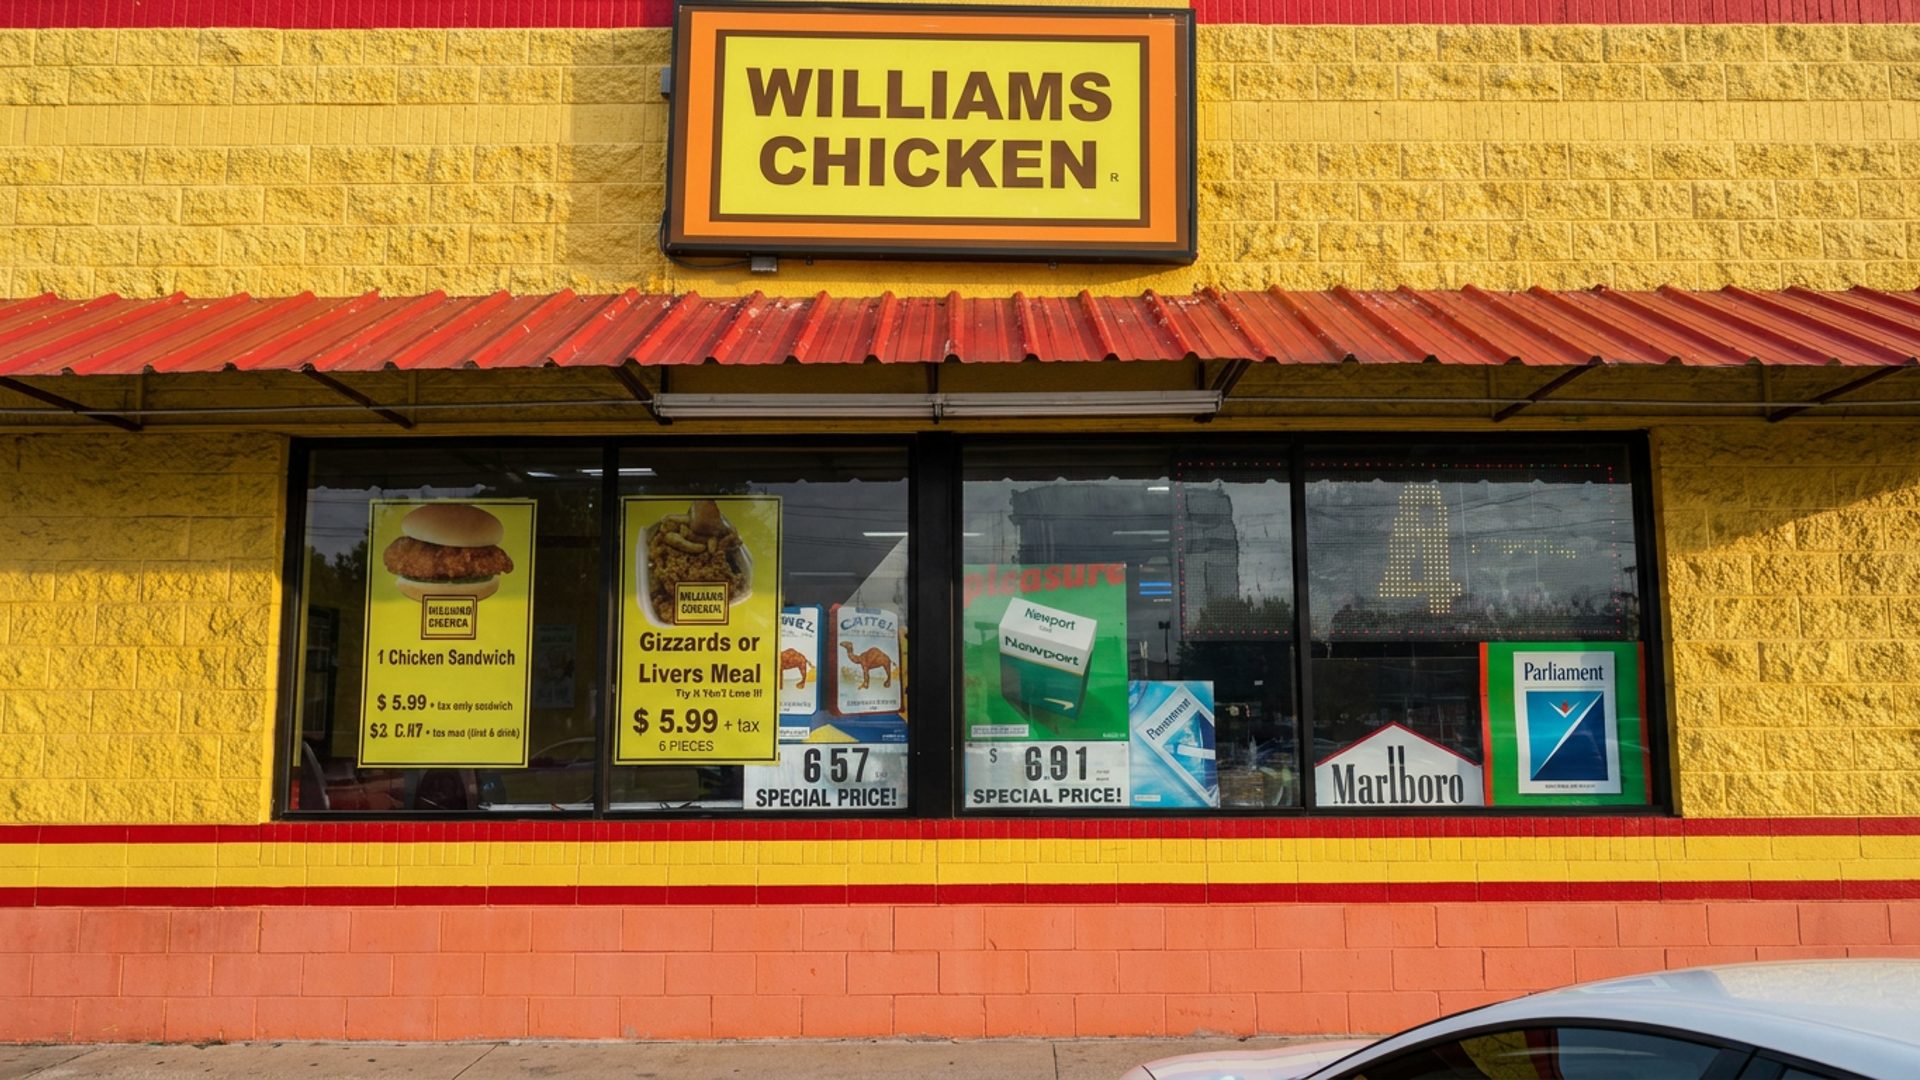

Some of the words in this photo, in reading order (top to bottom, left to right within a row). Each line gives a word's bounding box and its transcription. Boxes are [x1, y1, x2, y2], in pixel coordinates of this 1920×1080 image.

[746, 67, 1113, 122] WILLIAMS
[759, 135, 1097, 189] CHICKEN
[1024, 607, 1076, 631] Newport
[639, 632, 731, 652] Gizzards
[738, 636, 760, 652] or
[377, 649, 384, 665] 1
[389, 649, 444, 665] Chicken
[448, 649, 515, 665] Sandwich
[639, 663, 704, 683] Livers
[711, 663, 761, 683] Meal
[1524, 661, 1604, 681] Parliament
[376, 693, 387, 711] $
[392, 694, 427, 711] 5.99
[632, 707, 649, 736] $
[659, 708, 718, 733] 5.99
[738, 718, 760, 733] tax
[659, 740, 666, 752] 6
[669, 740, 714, 752] PIECES
[989, 747, 998, 764] $
[1332, 745, 1464, 804] Marlboro
[756, 788, 831, 807] SPECIAL
[837, 788, 896, 807] PRICE!
[973, 788, 1053, 804] SPECIAL
[1058, 787, 1122, 803] PRICE!
